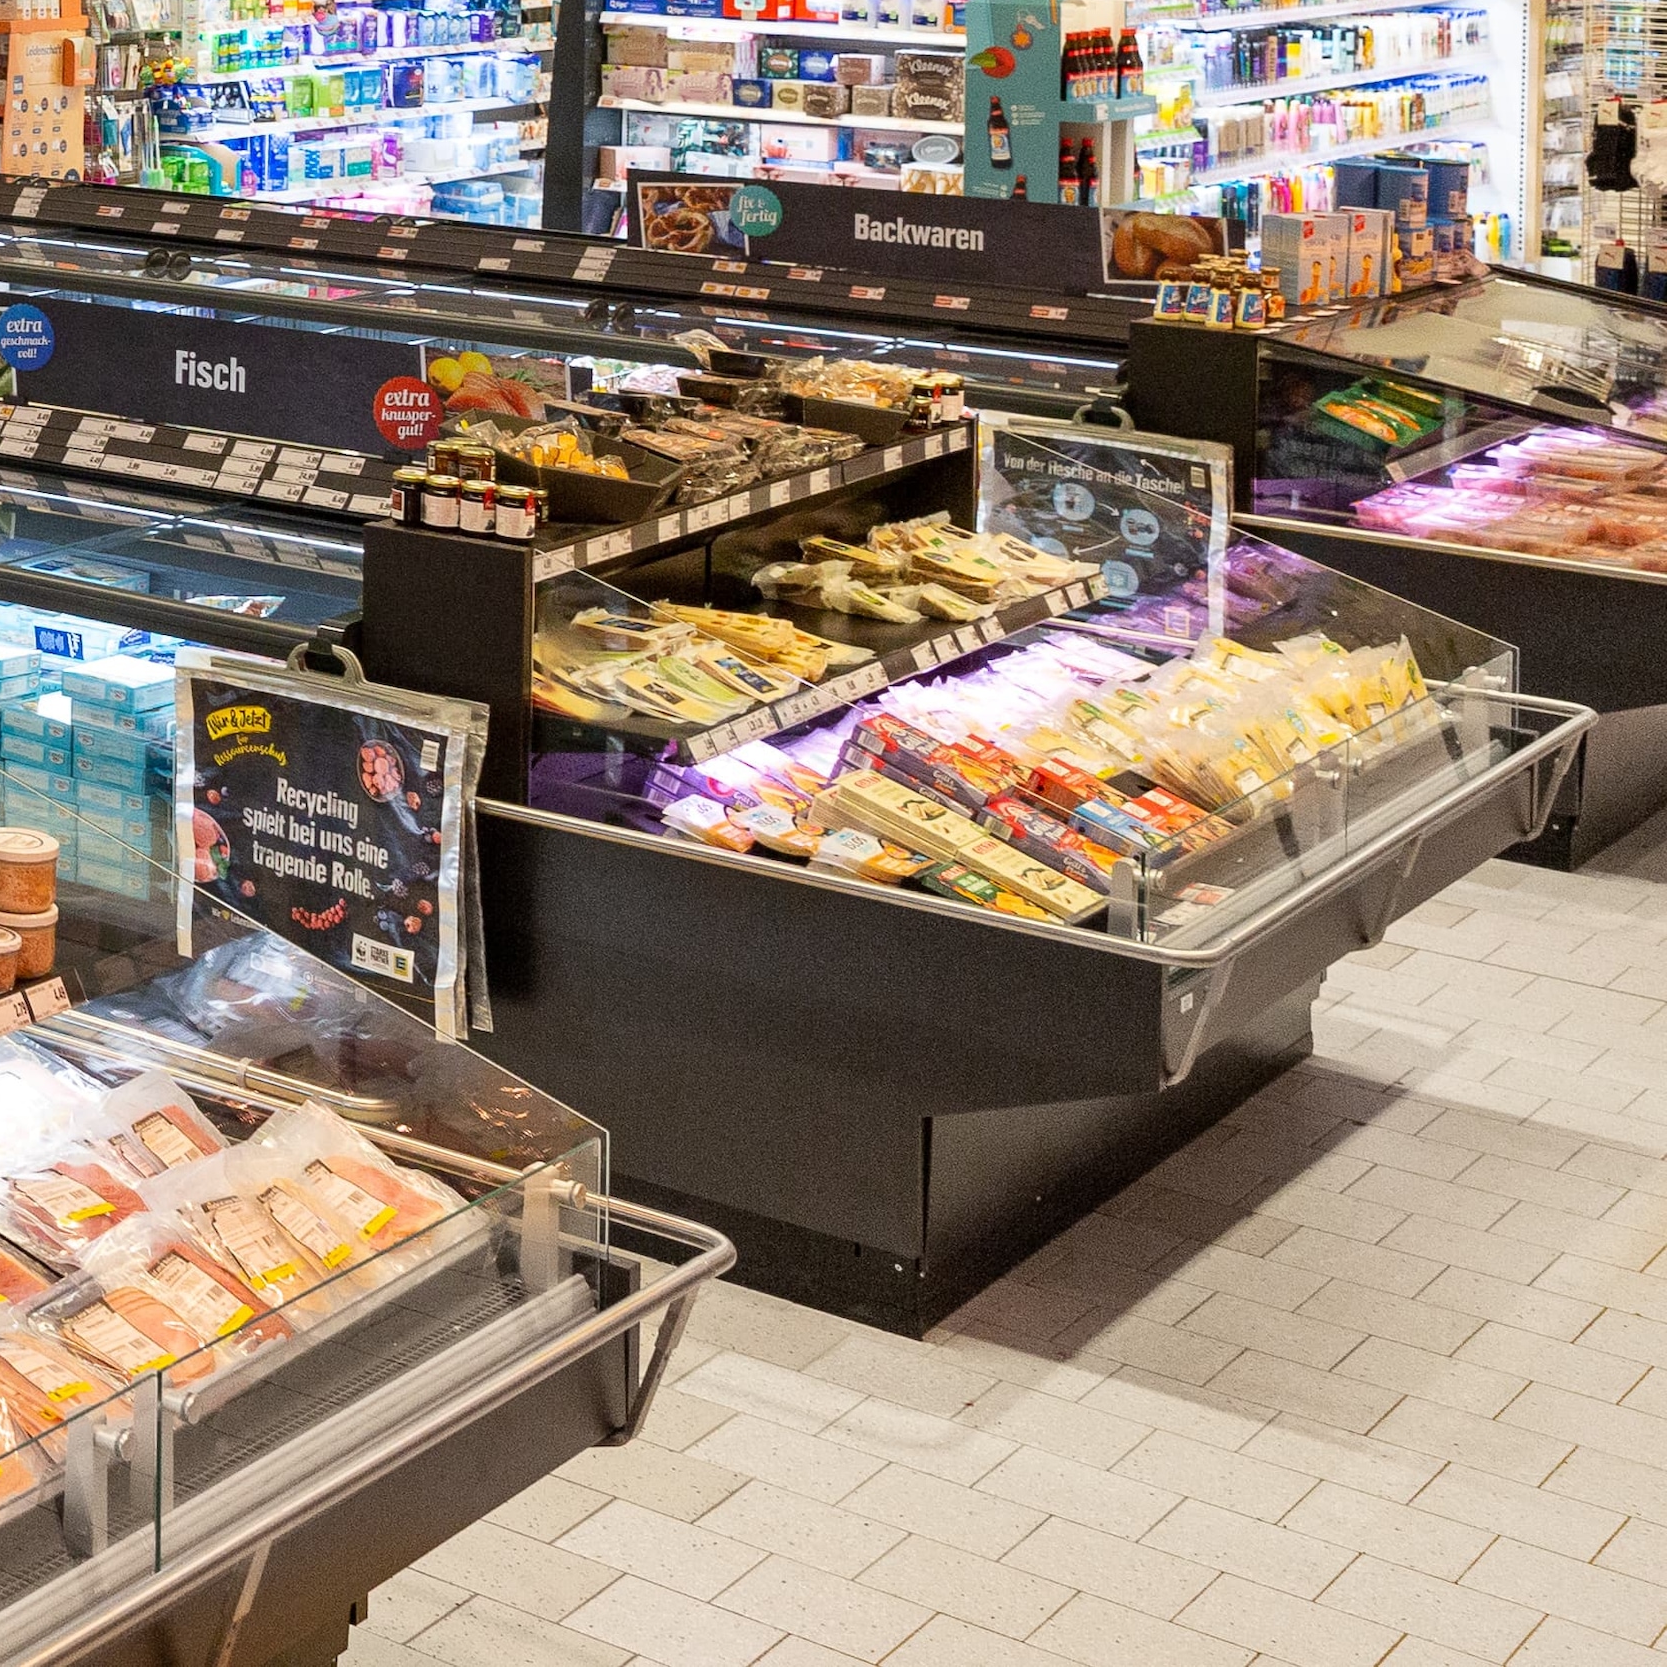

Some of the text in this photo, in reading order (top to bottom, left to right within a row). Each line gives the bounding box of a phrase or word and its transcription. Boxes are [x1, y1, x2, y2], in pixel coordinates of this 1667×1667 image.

[909, 59, 952, 77] Kleenex
[904, 92, 949, 110] Kleenex
[739, 207, 777, 227] fertig
[854, 213, 984, 252] Backwaren
[5, 317, 43, 334] extra
[0, 333, 52, 348] geschmack-
[17, 346, 37, 360] voll!
[175, 349, 246, 394] Fisch
[384, 389, 430, 407] extra
[381, 407, 436, 425] knusper-
[397, 423, 423, 440] gut!
[1003, 452, 1024, 469] Von
[1027, 456, 1045, 472] der
[1134, 473, 1185, 495] Tasche!
[239, 709, 269, 728] Jetzt
[276, 776, 359, 830] Recycling
[243, 806, 389, 870] spielt bei uns eine
[252, 840, 376, 900] tragende Rolle.
[53, 986, 67, 1002] 4.49
[13, 1001, 27, 1018] 2.79
